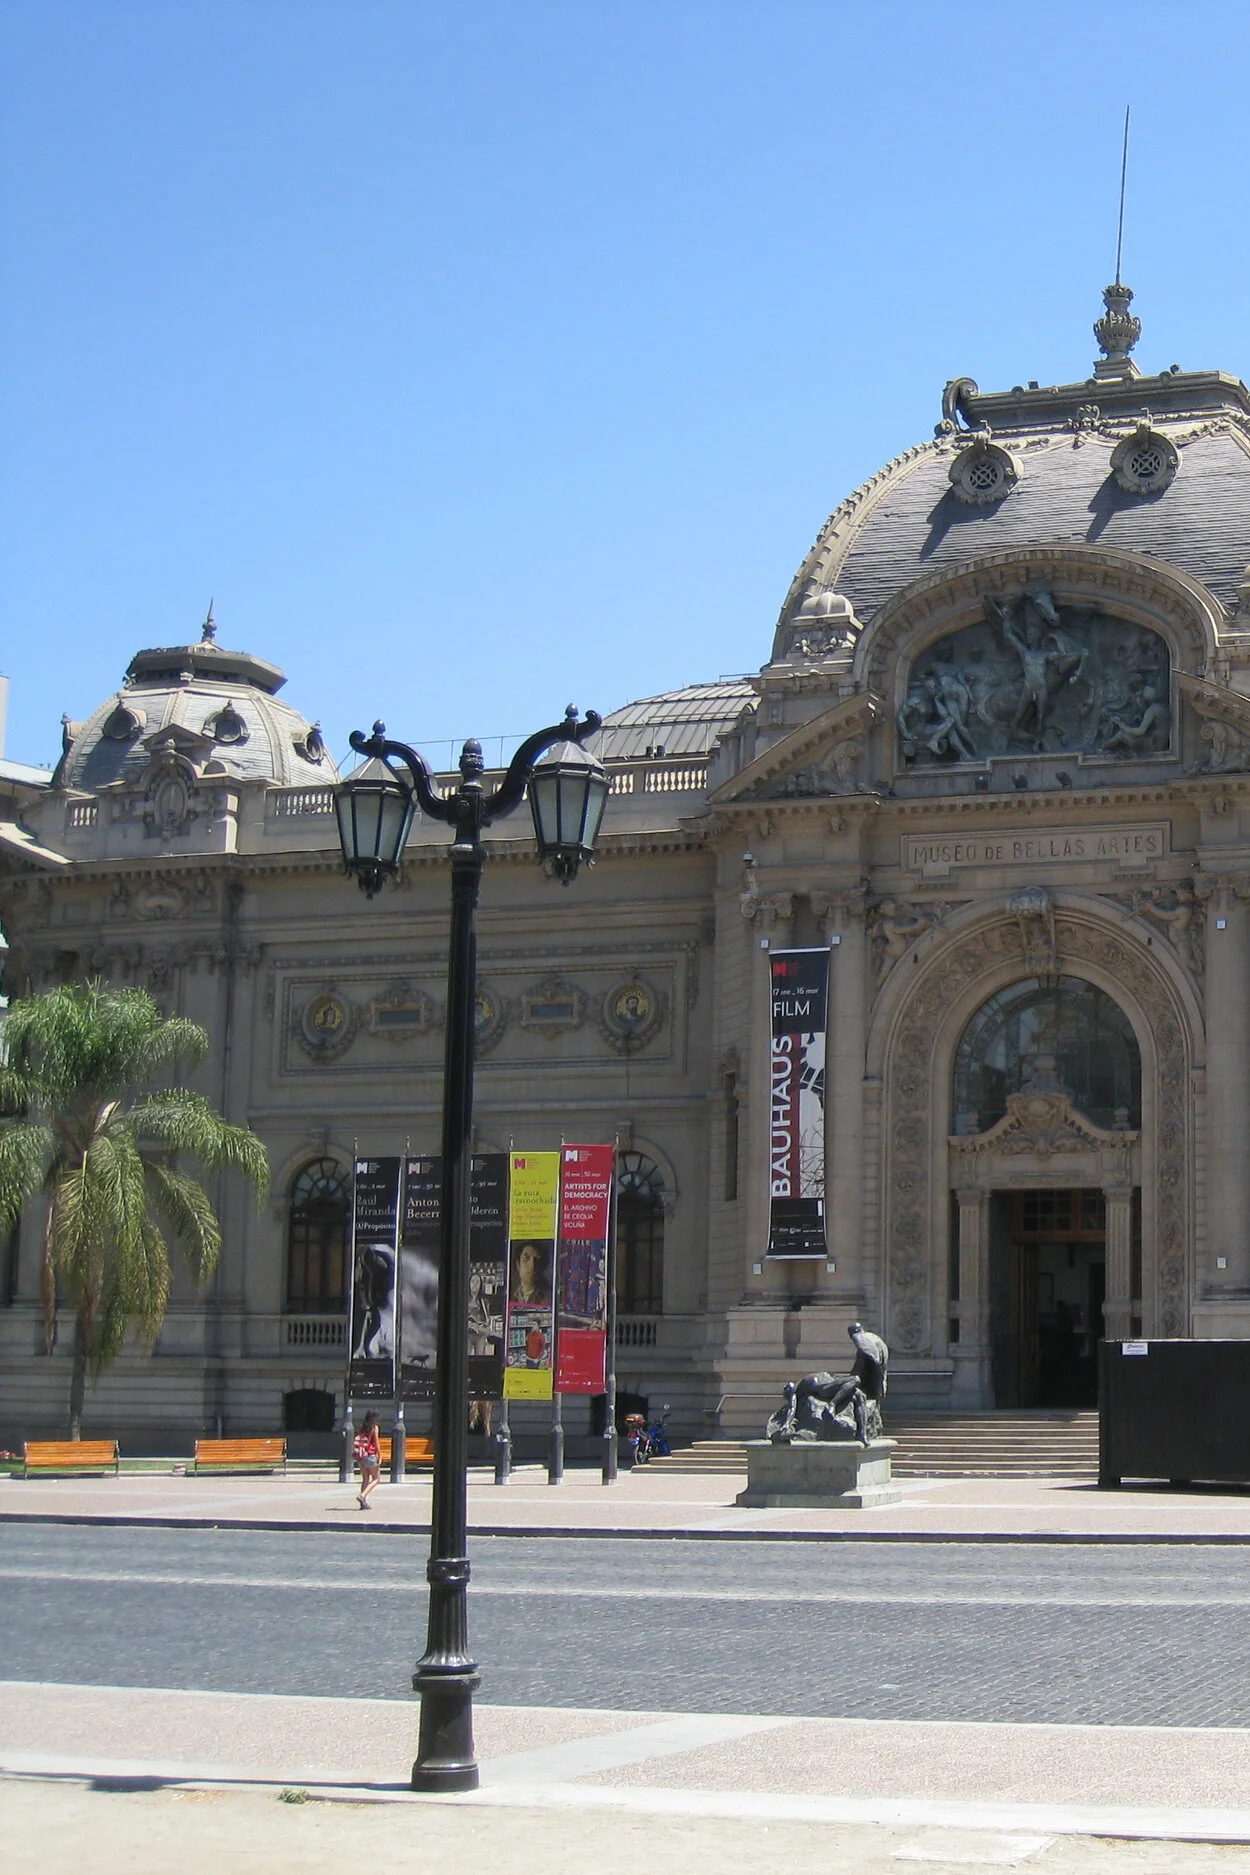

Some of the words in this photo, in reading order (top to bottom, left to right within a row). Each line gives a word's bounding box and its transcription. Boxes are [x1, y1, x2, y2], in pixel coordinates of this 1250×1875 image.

[914, 844, 976, 864] MUSEO
[985, 846, 1003, 861] DE
[1013, 838, 1085, 860] BELLAS
[1096, 835, 1157, 856] ARTES
[773, 1000, 811, 1018] FILM
[771, 1035, 793, 1198] BAUHAUS
[564, 1191, 608, 1199] DEMOCRACY
[407, 1197, 440, 1208] Anton
[407, 1208, 440, 1219] Becerr
